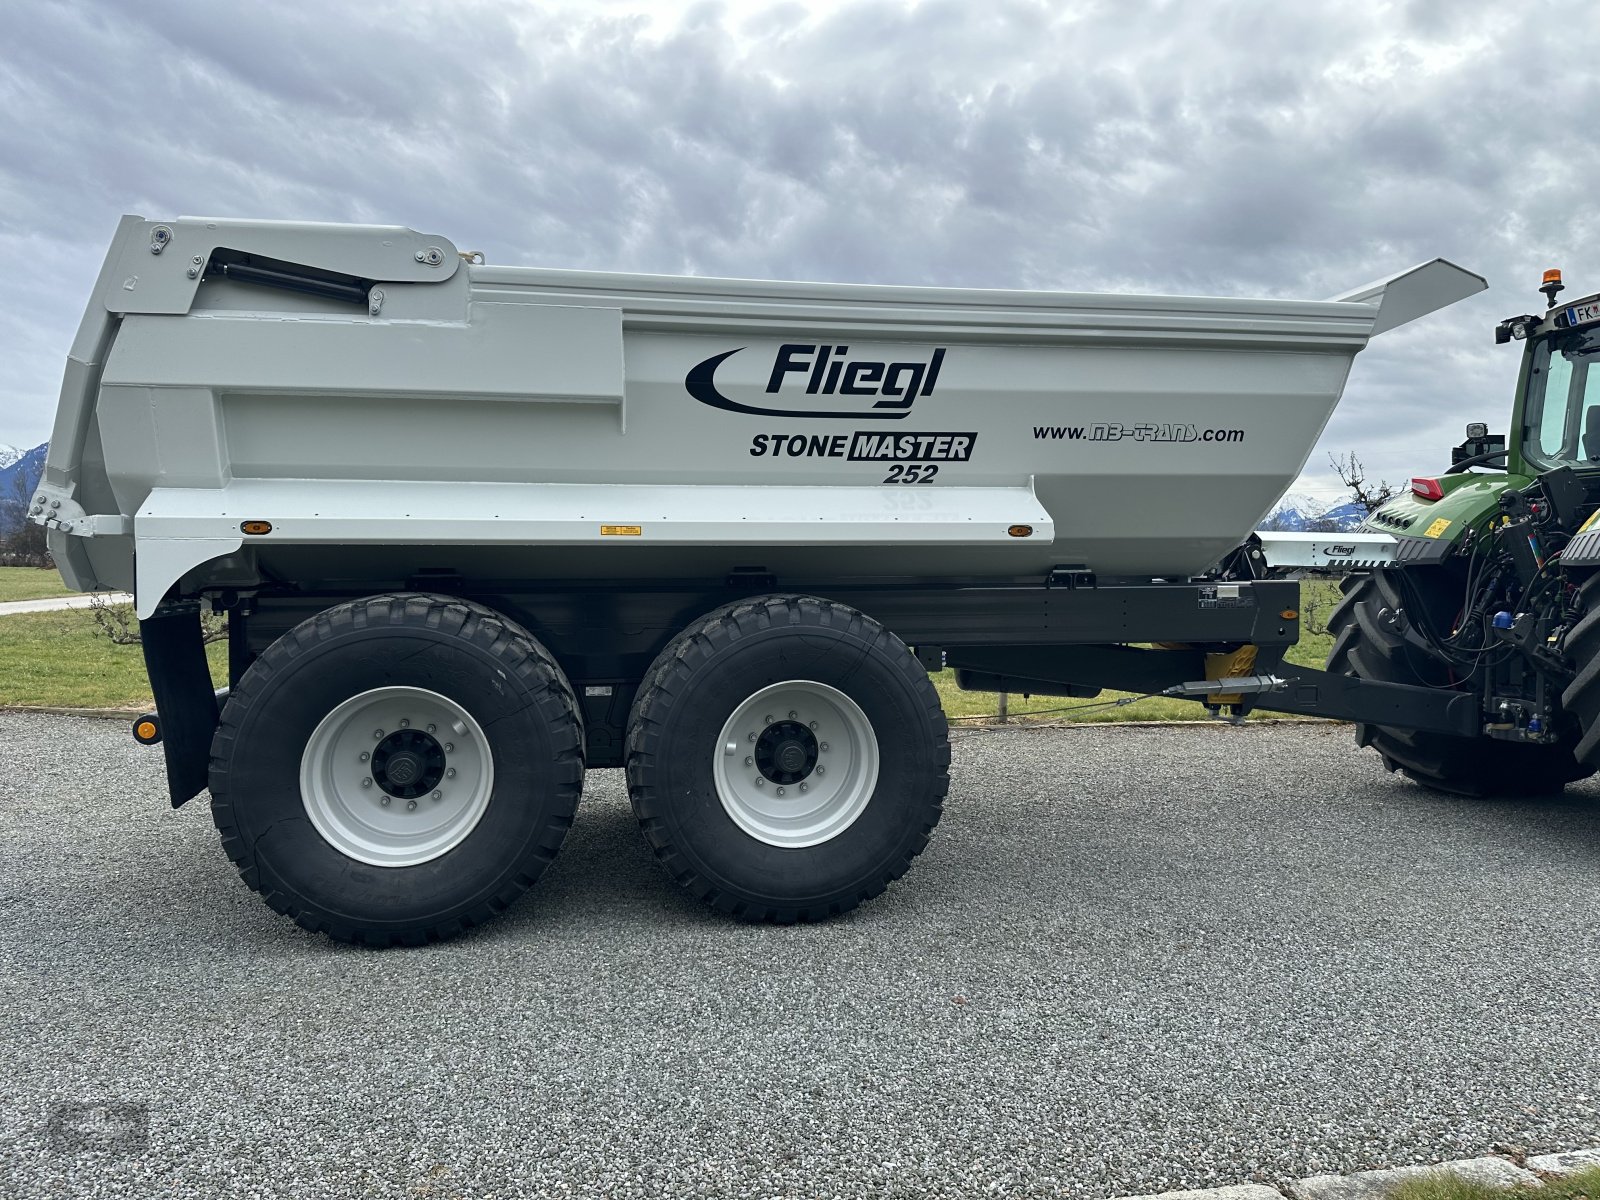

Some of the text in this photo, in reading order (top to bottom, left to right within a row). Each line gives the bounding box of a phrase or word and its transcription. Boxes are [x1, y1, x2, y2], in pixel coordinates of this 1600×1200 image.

[1577, 306, 1594, 321] FK
[765, 344, 947, 408] Fliegl
[750, 435, 970, 458] STONE MASTER
[883, 464, 939, 484] 252
[1332, 545, 1356, 555] Fliegl
